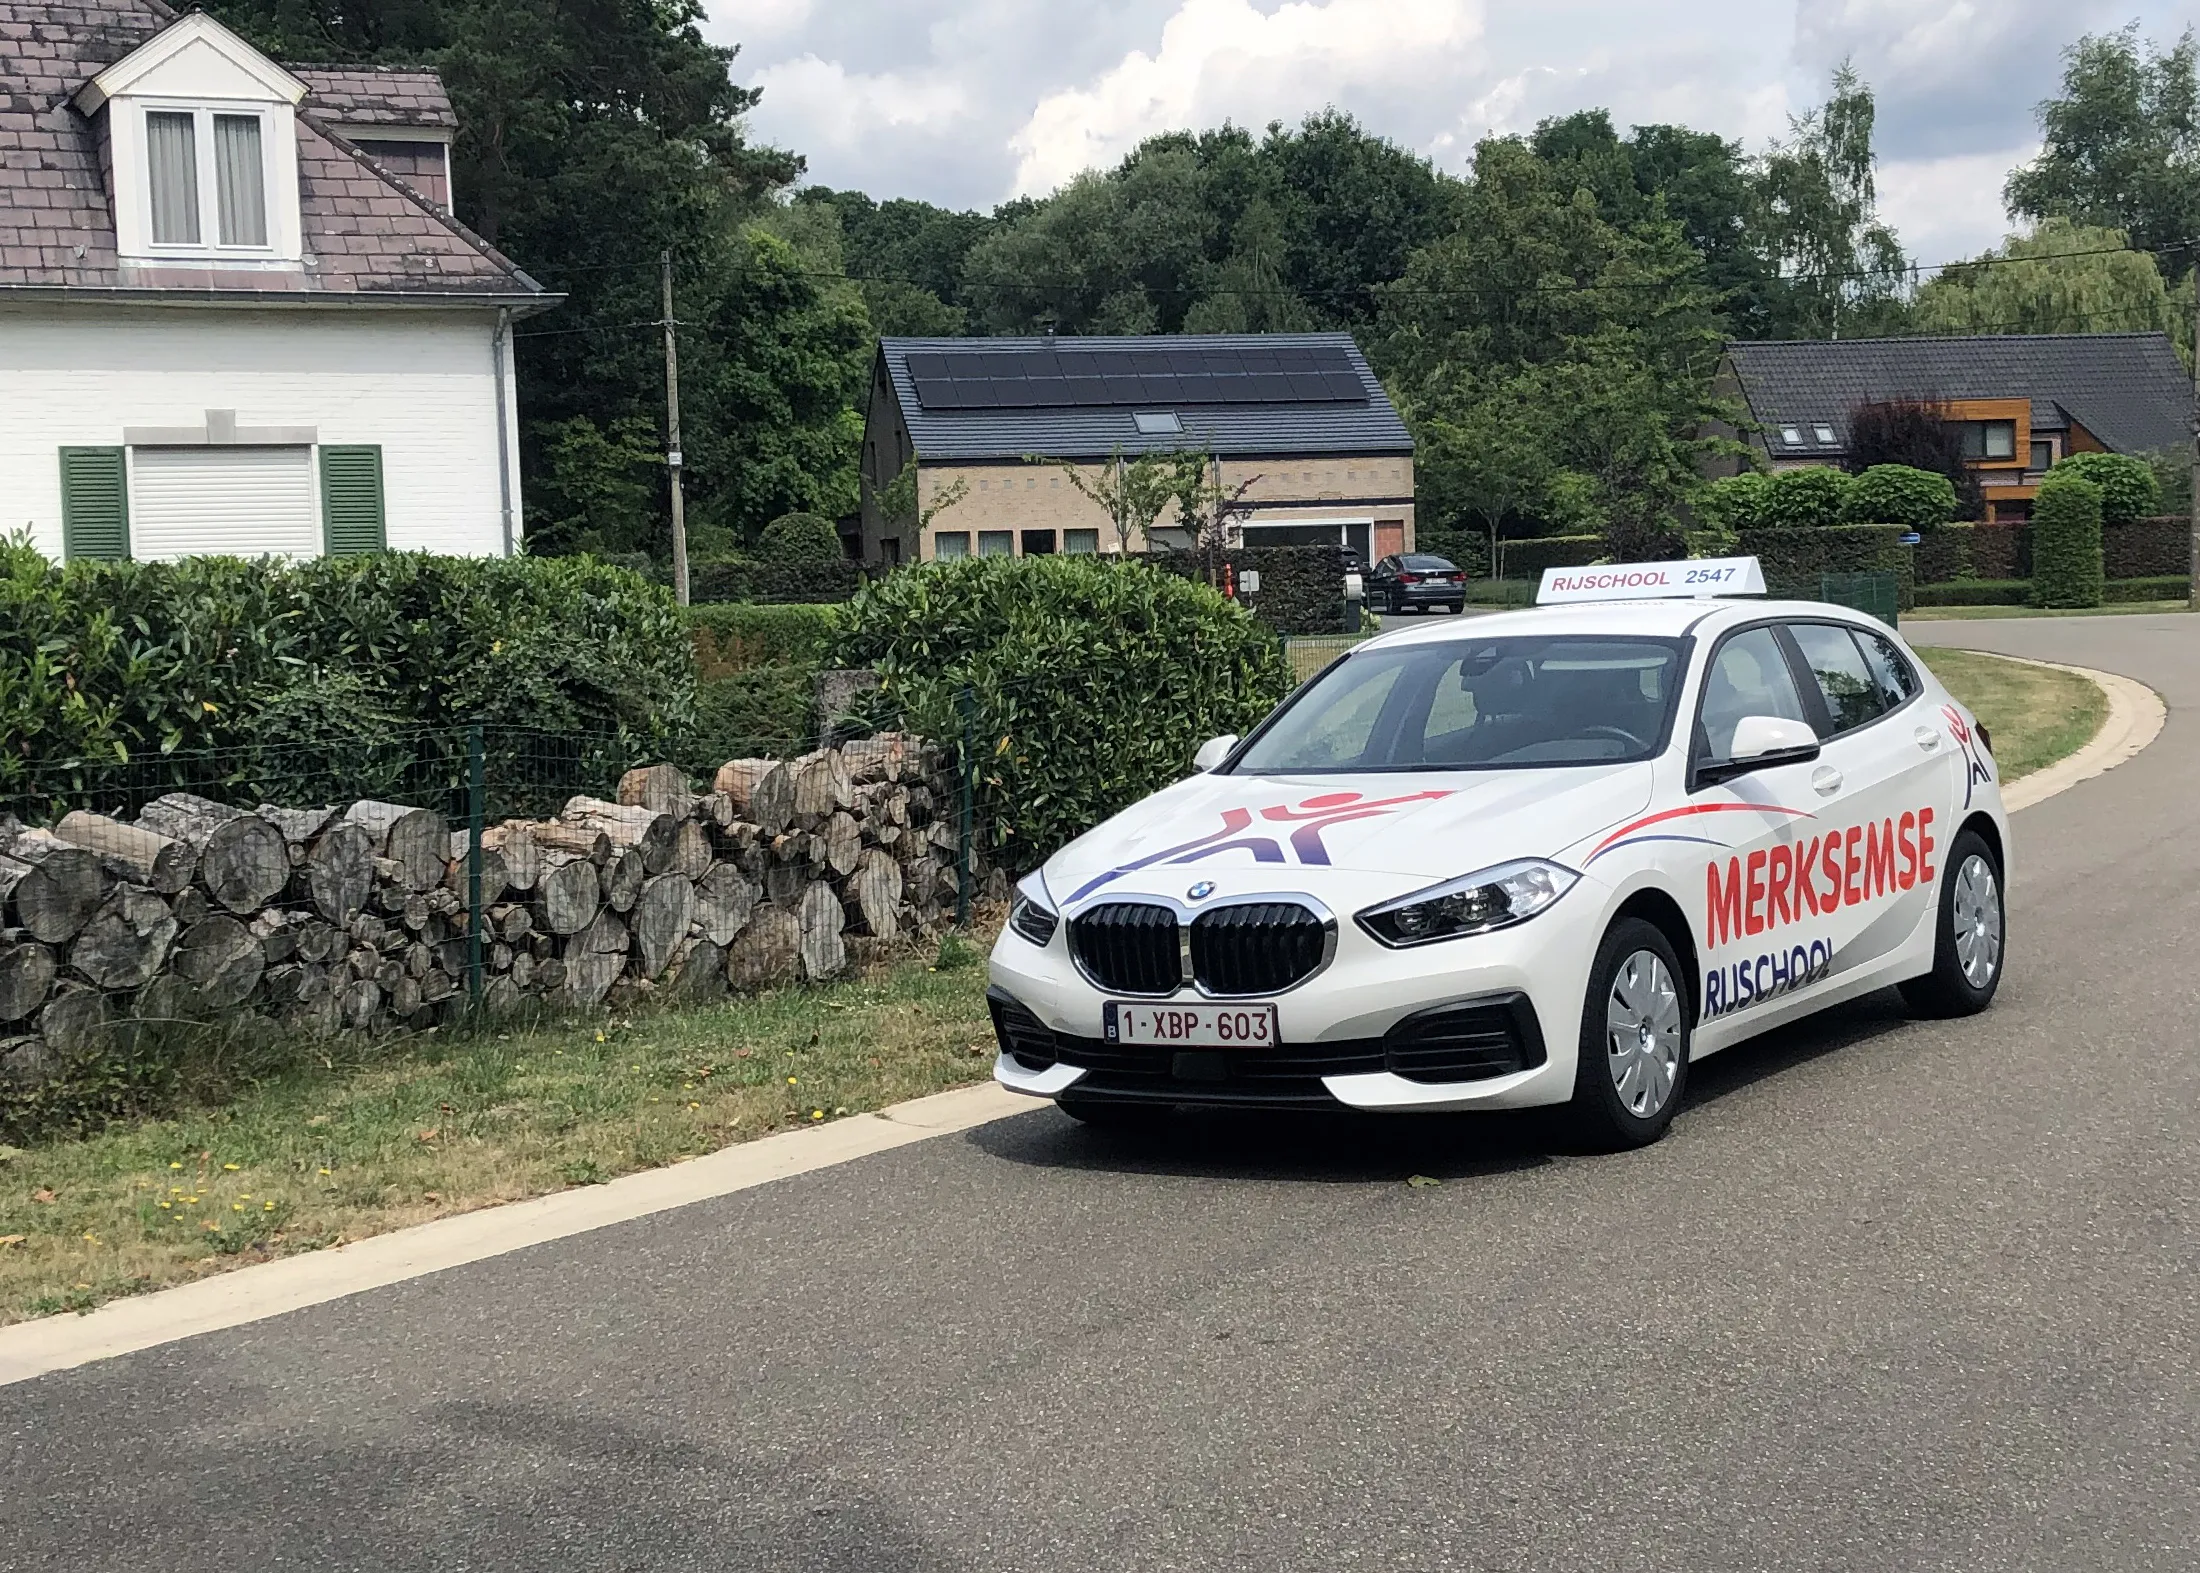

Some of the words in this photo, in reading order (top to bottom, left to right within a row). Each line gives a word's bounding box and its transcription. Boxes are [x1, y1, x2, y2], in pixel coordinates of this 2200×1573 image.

[1551, 571, 1671, 592] RIJSCHOOL
[1684, 568, 1736, 584] 2547
[1707, 807, 1934, 950] MERKSEMSE
[1703, 937, 1832, 1020] RIJSCHOOL
